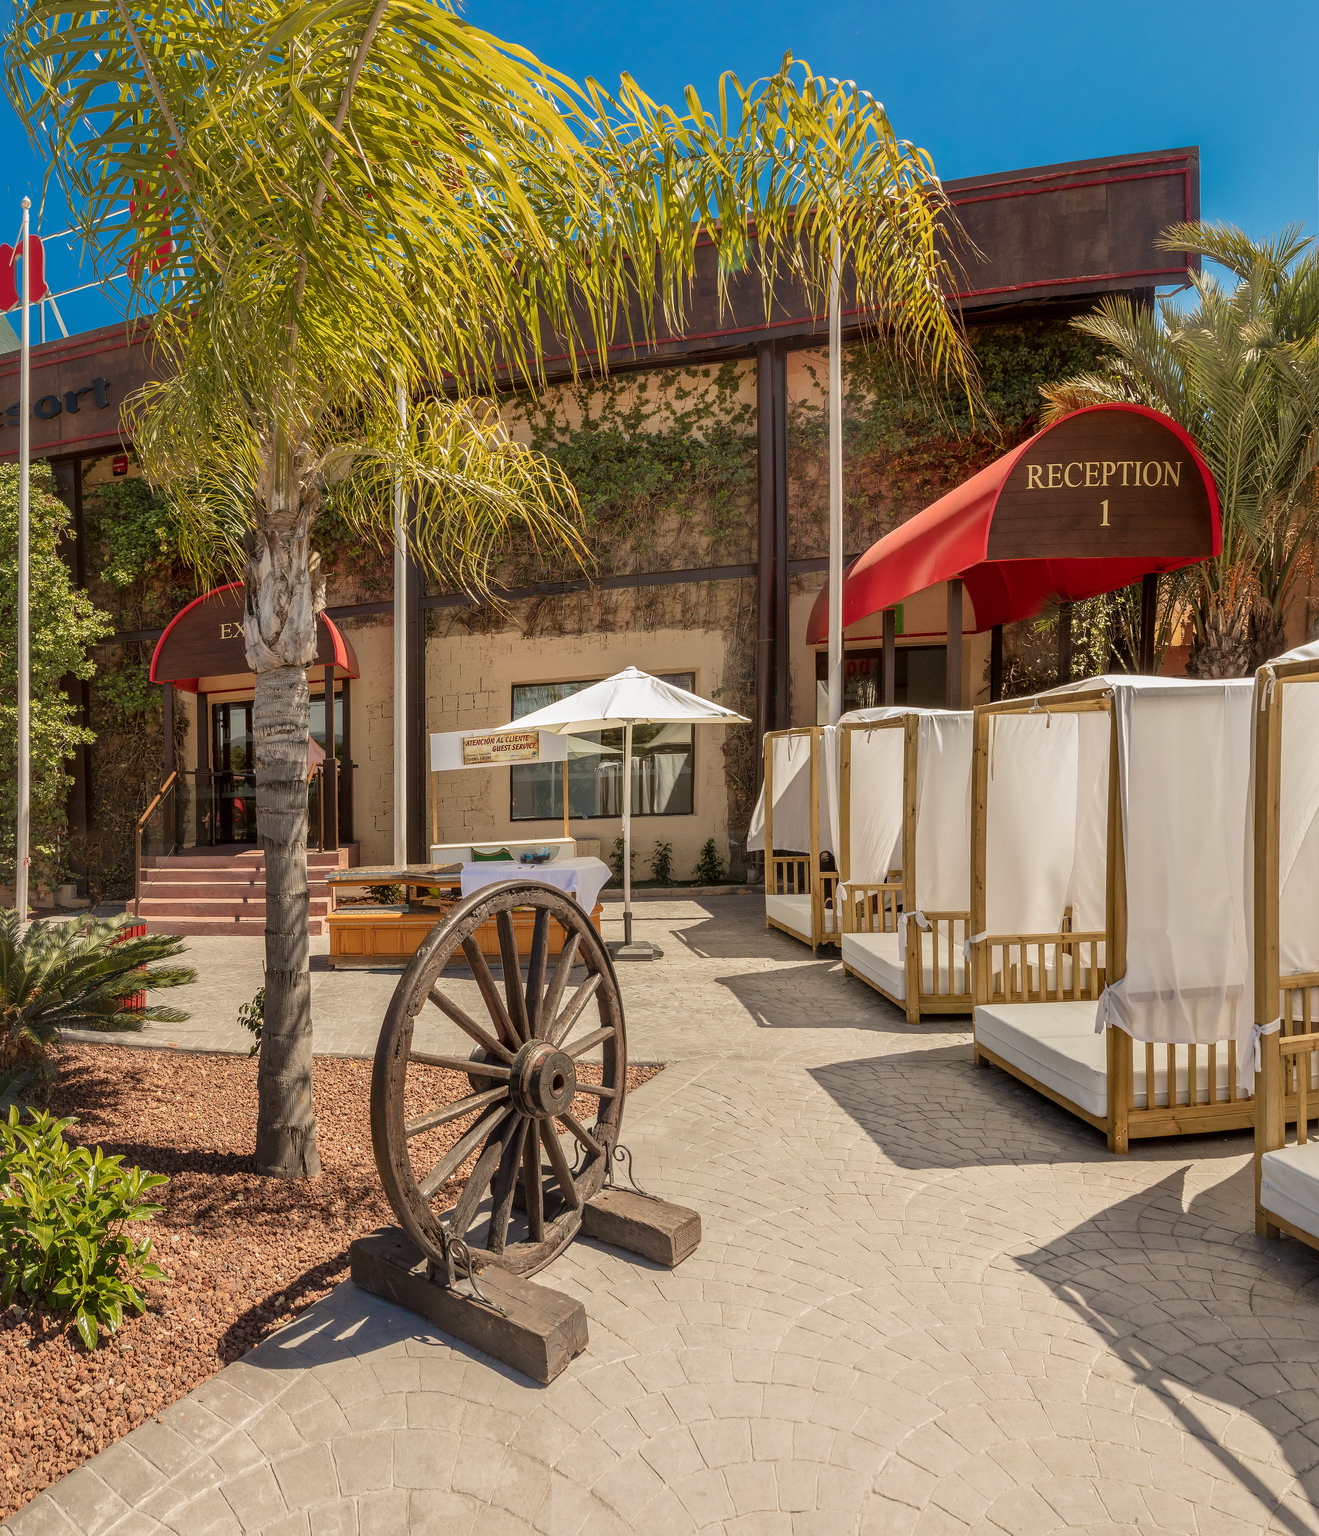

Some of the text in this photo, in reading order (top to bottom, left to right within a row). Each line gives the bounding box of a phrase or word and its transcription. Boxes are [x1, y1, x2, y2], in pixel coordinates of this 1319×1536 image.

[1025, 460, 1183, 490] RECEPTION
[1099, 499, 1111, 527] 1
[219, 621, 245, 640] EX
[465, 734, 530, 746] ATENCIÓN AL CLIENTE
[492, 742, 537, 752] GUEST SERVICE
